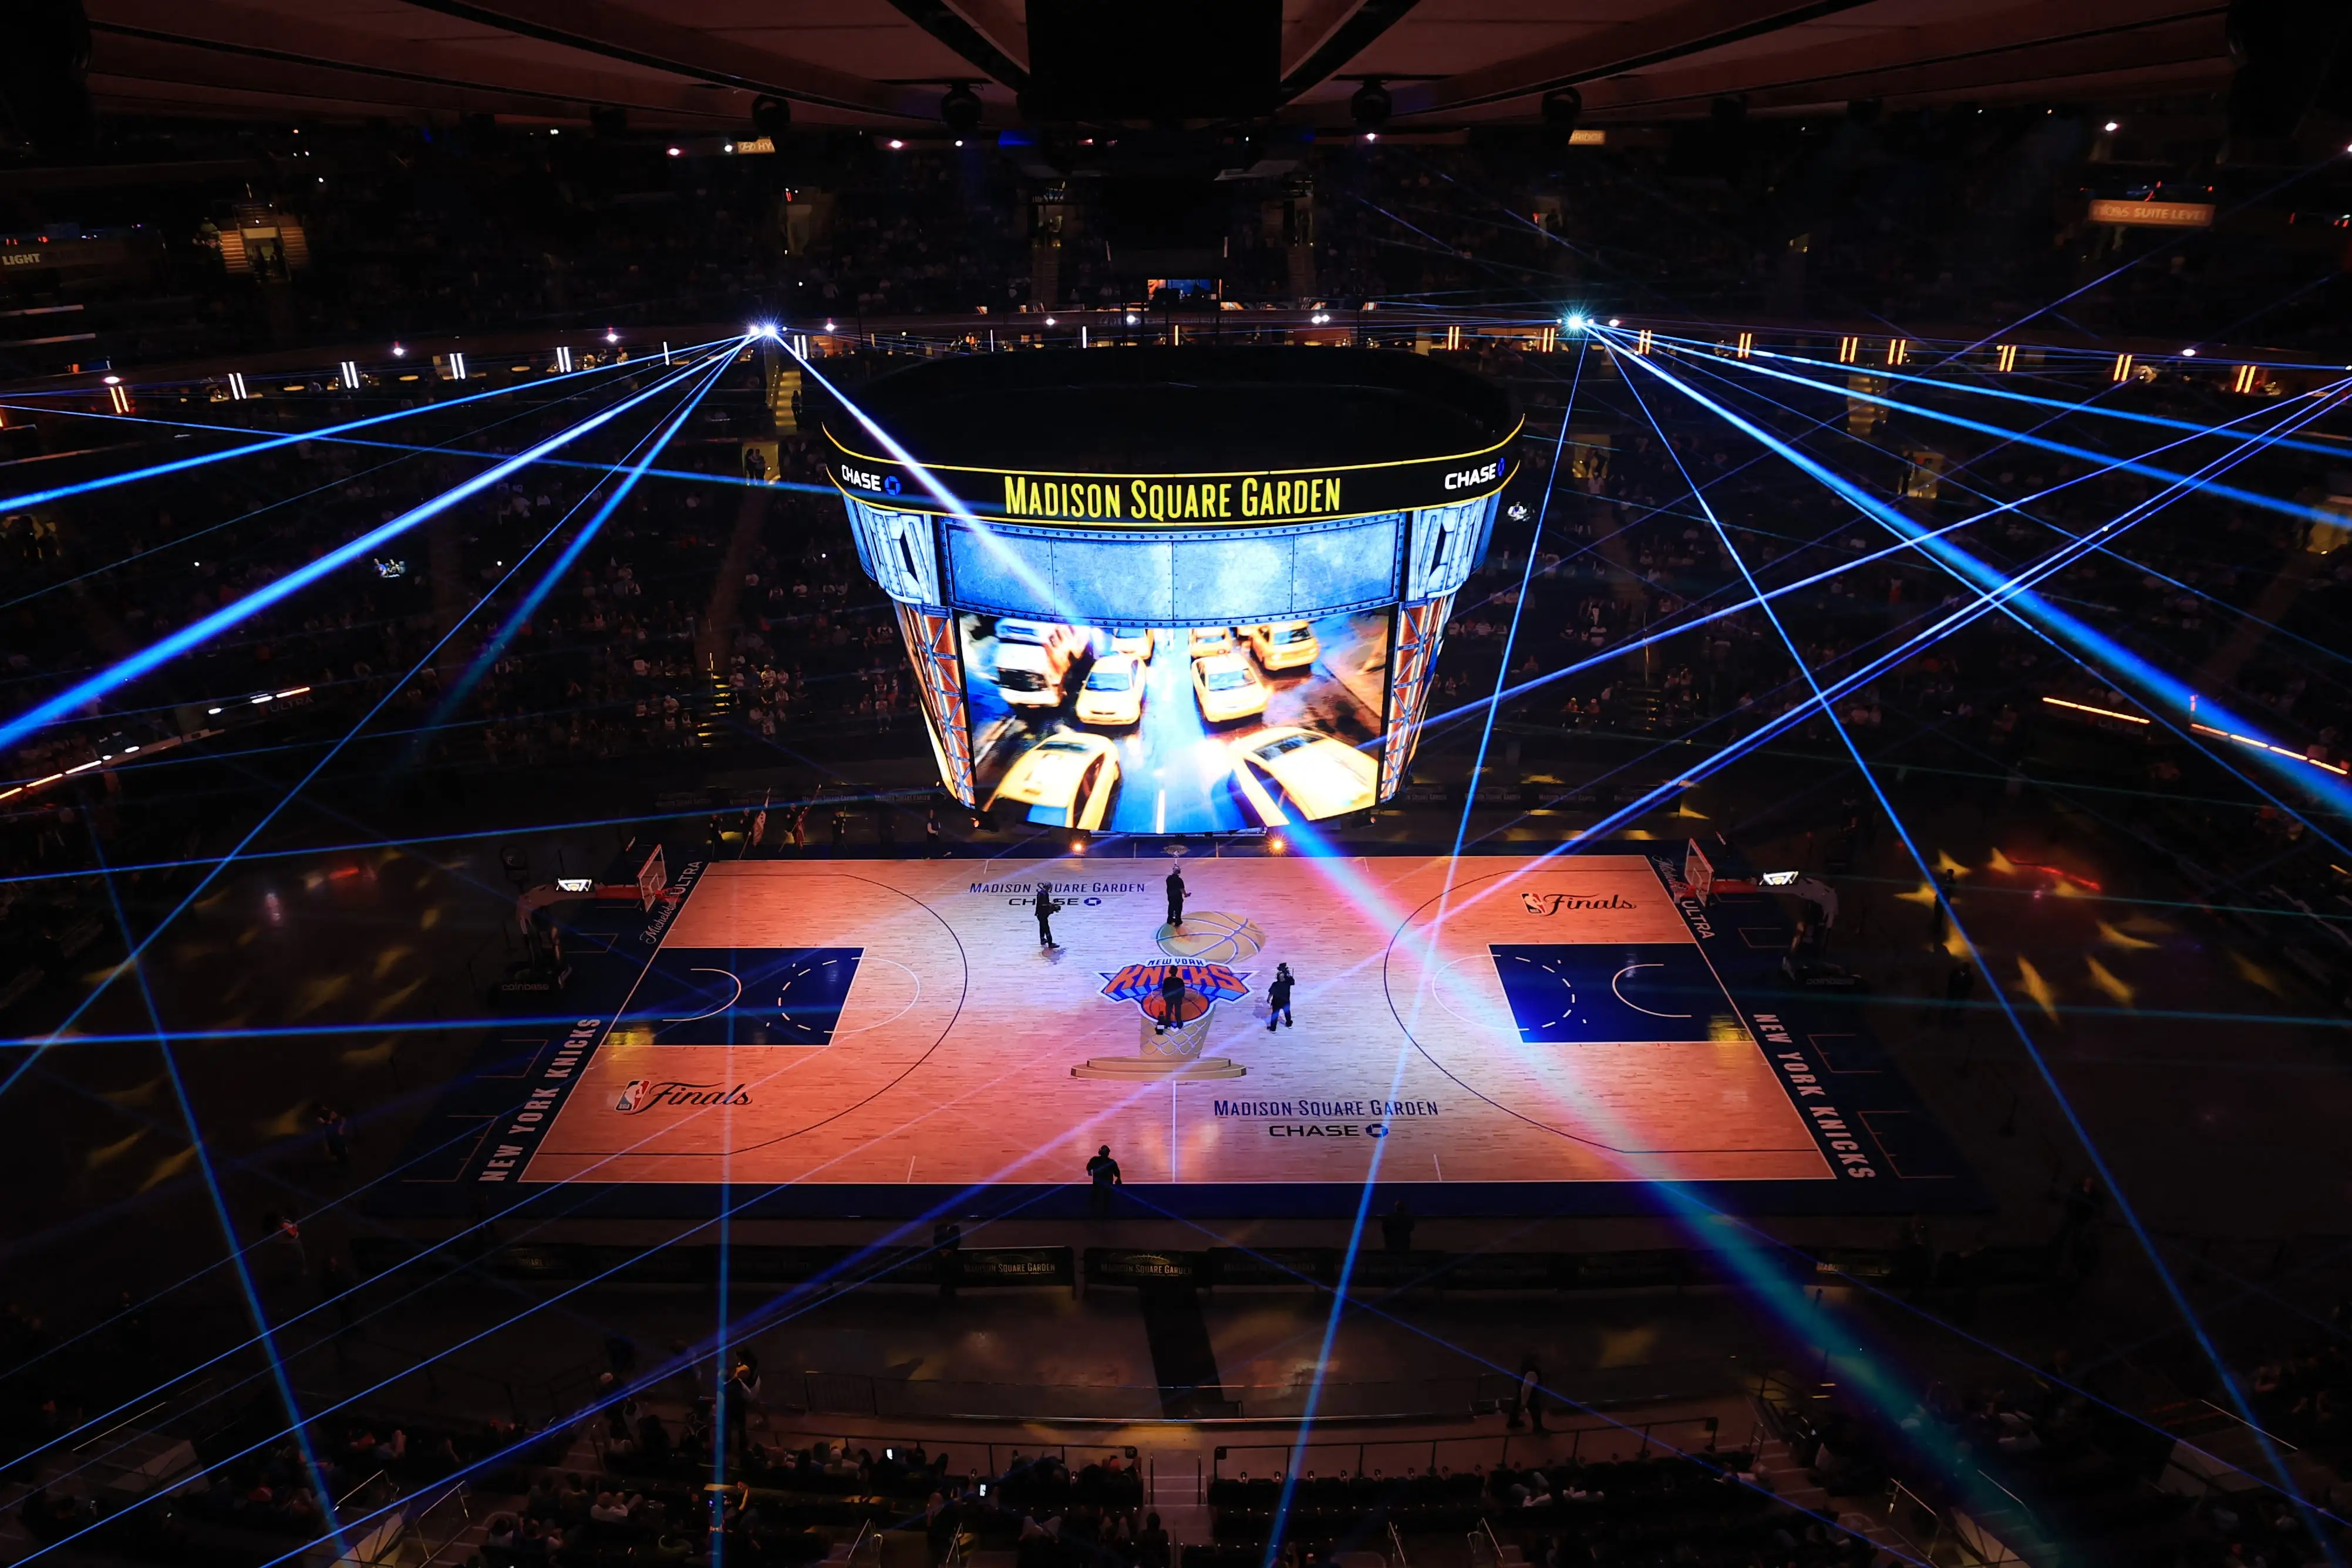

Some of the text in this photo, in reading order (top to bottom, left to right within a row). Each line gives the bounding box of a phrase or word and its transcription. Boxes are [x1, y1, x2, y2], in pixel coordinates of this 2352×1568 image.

[2134, 207, 2168, 219] SUITE
[1, 252, 41, 265] LIGHT
[841, 464, 881, 491] CHASE
[1444, 463, 1497, 490] CHASE
[1005, 476, 1341, 521] MADISON SQUARE GARDEN
[269, 695, 315, 713] ULTRA
[669, 861, 703, 895] ULTRA
[1541, 893, 1637, 917] Finals
[1681, 900, 1716, 939] ULTRA
[501, 980, 550, 991] coinbase
[478, 1019, 601, 1181] NEW YORK KNICKS
[624, 1081, 753, 1115] Finals
[1753, 1014, 1877, 1178] NEW YORK KNICKS
[1214, 1100, 1439, 1117] MADISON SQUARE GARDEN
[1268, 1125, 1360, 1137] CHASE
[998, 1263, 1026, 1273] SQUARE
[1027, 1262, 1056, 1272] GARDEN
[1135, 1264, 1163, 1274] SQUARE
